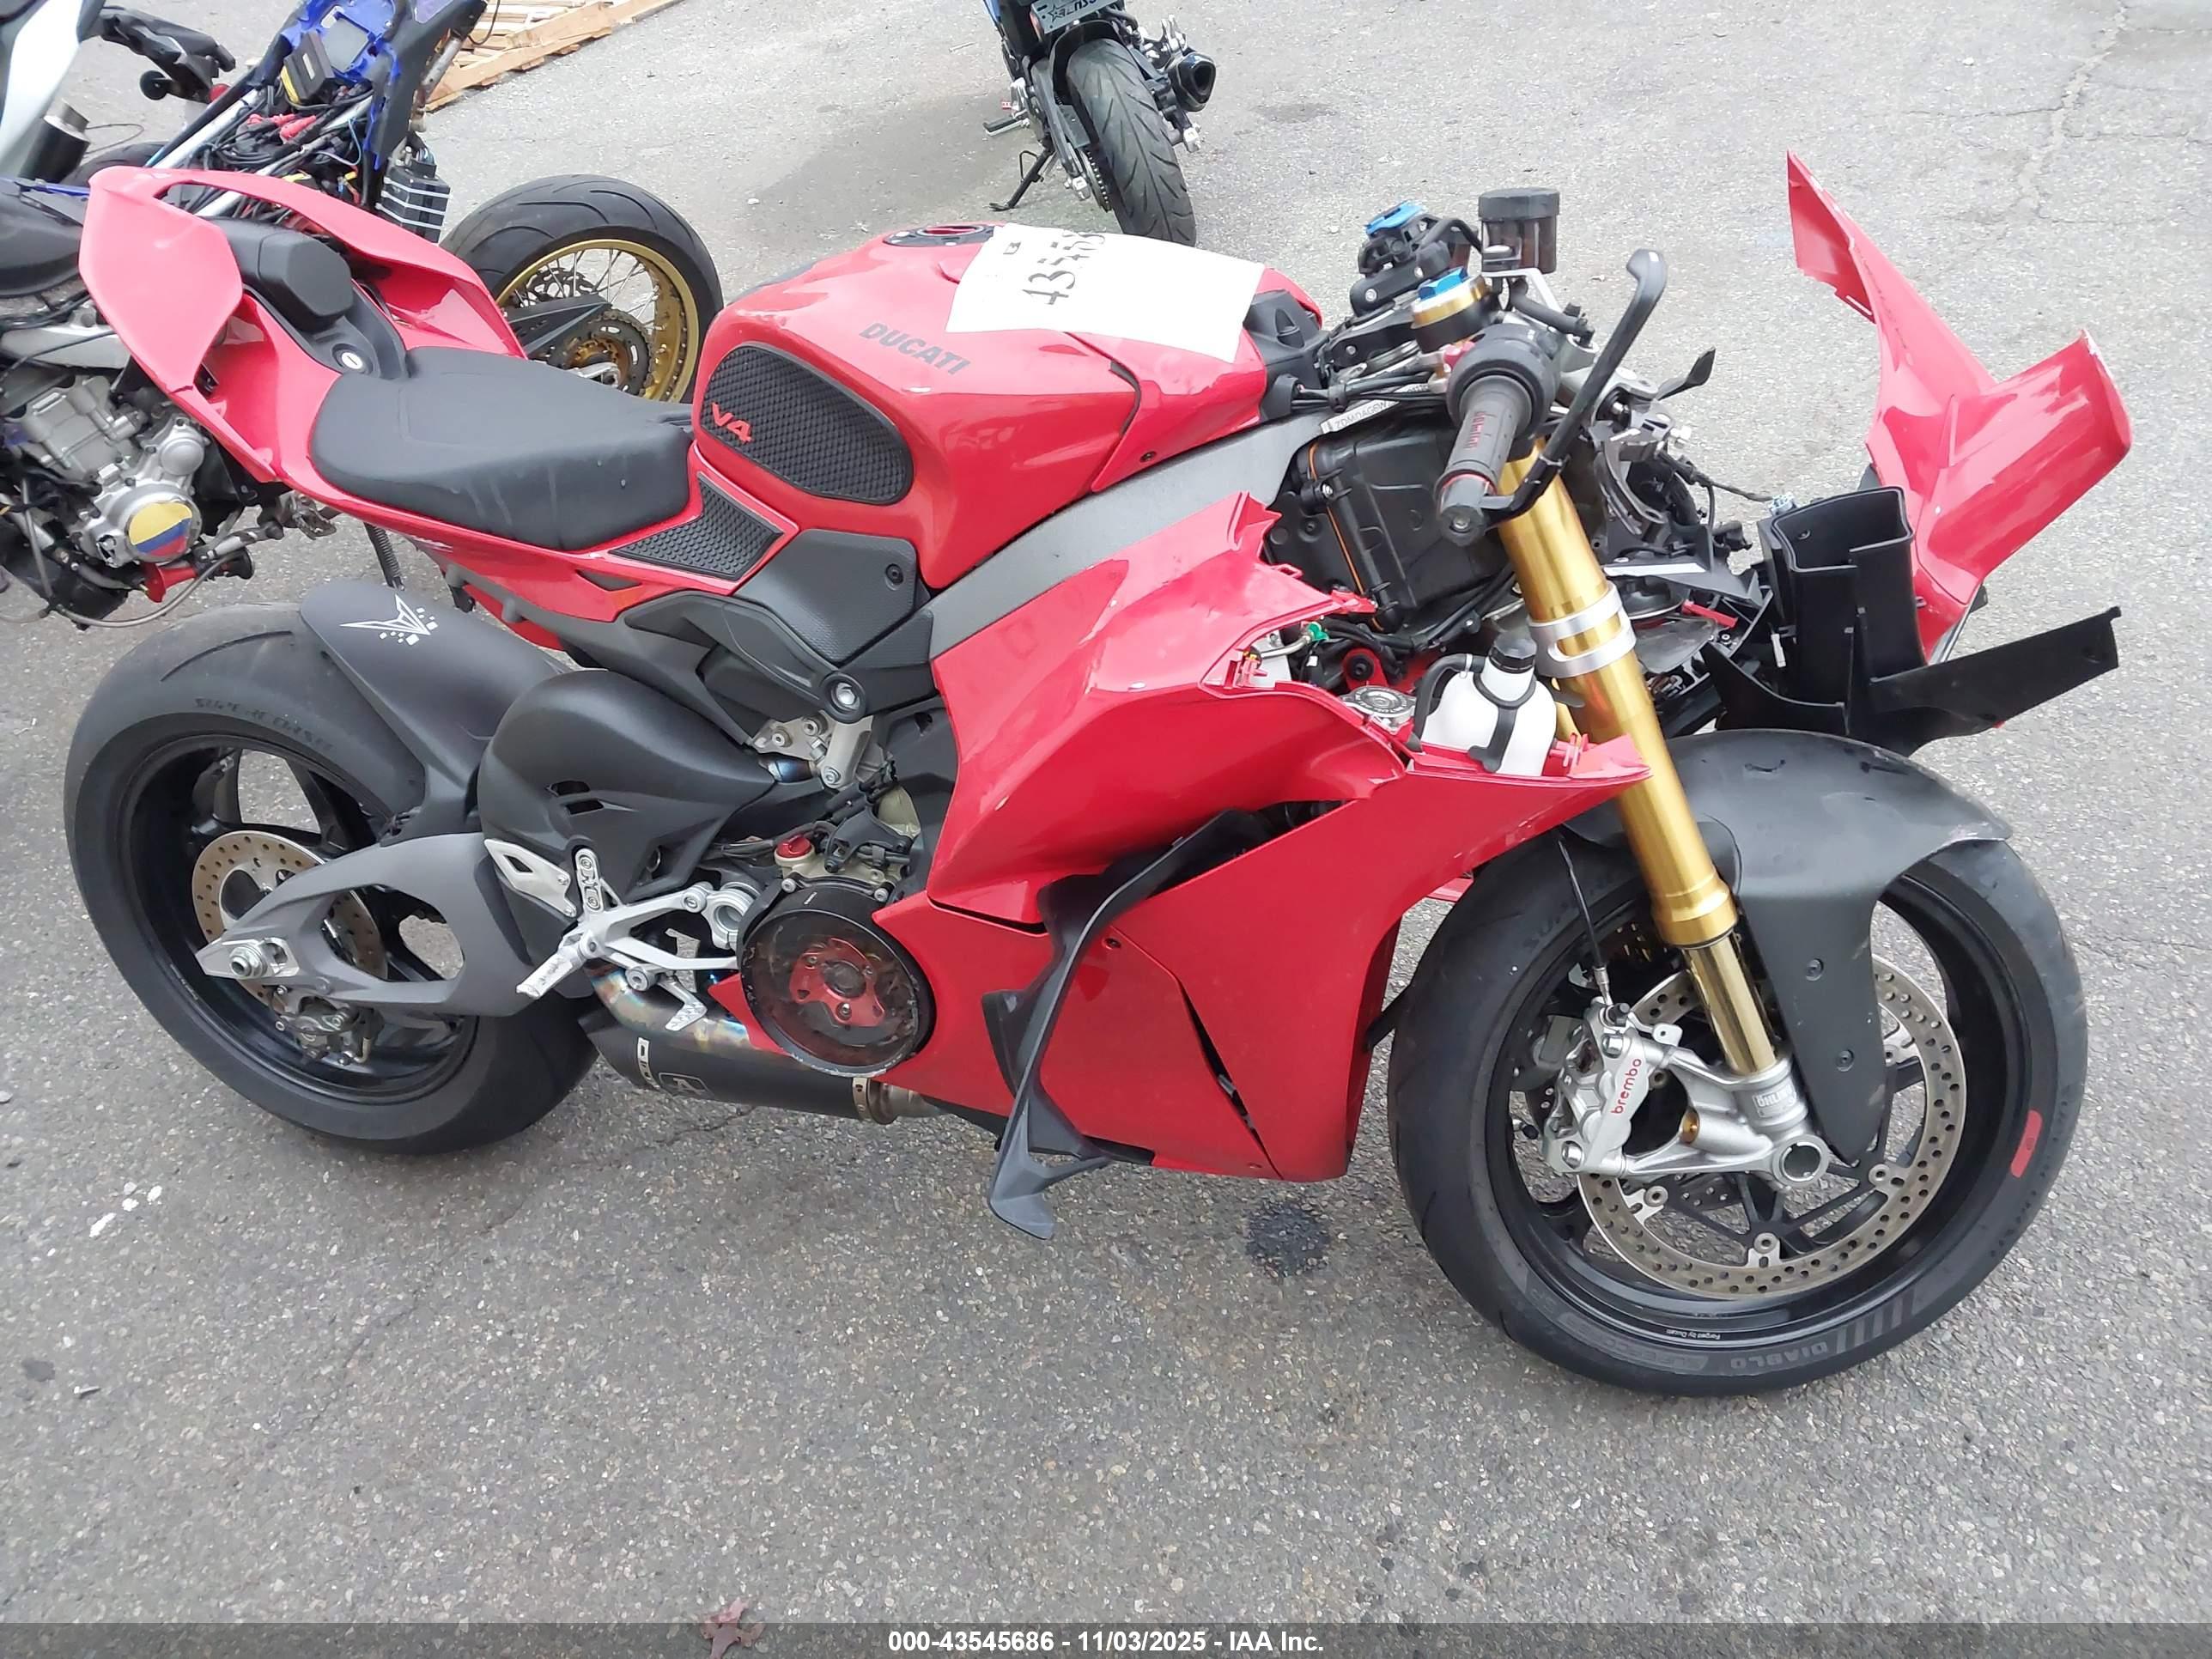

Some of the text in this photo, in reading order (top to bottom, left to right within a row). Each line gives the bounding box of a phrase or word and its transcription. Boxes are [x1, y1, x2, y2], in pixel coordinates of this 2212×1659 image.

[859, 323, 970, 375] DUCATI
[712, 402, 751, 441] V4
[1610, 1059, 1642, 1114] brembo
[1730, 1341, 1828, 1369] DIABLO
